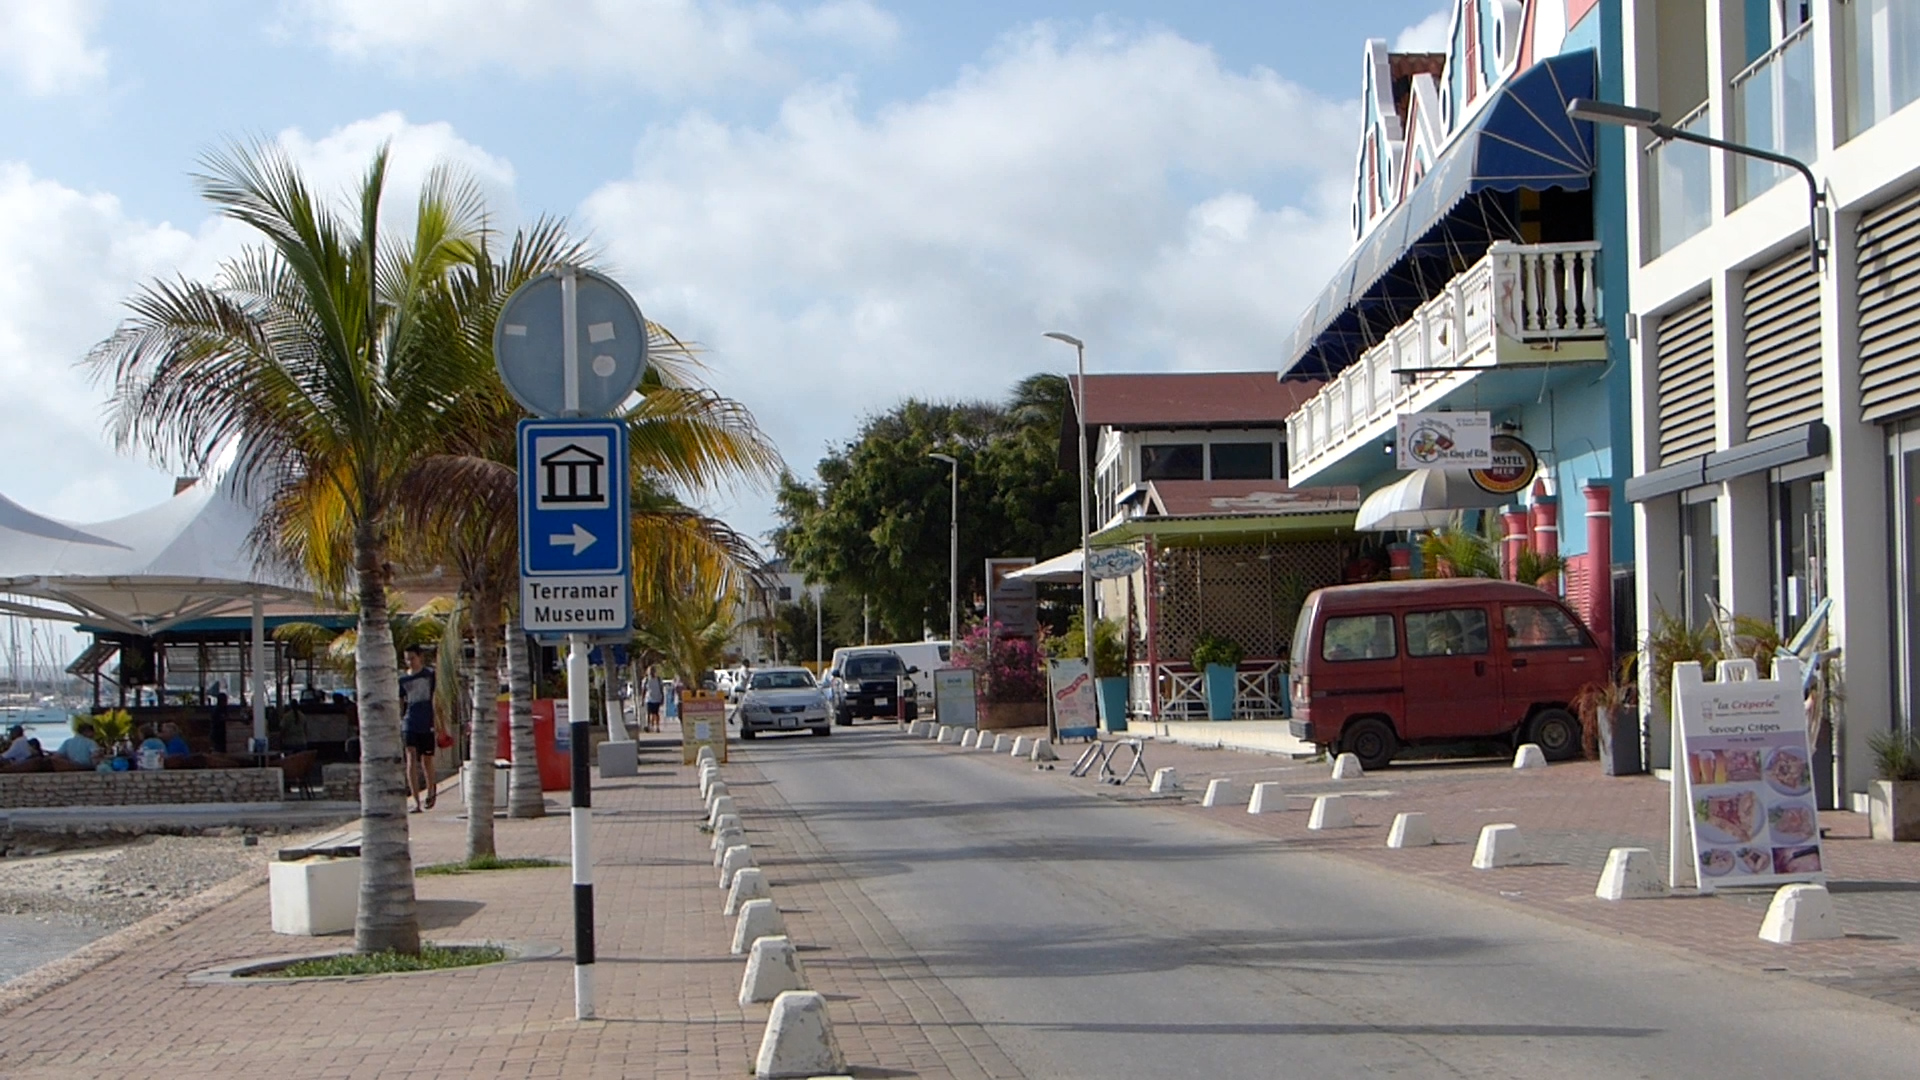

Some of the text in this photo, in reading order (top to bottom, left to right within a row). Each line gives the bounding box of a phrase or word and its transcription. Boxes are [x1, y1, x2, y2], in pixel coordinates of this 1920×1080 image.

[1492, 455, 1523, 465] MSTEL
[1493, 467, 1515, 475] BEER
[529, 582, 619, 600] Terramar
[534, 605, 615, 623] Museum
[1708, 723, 1745, 735] Savoury
